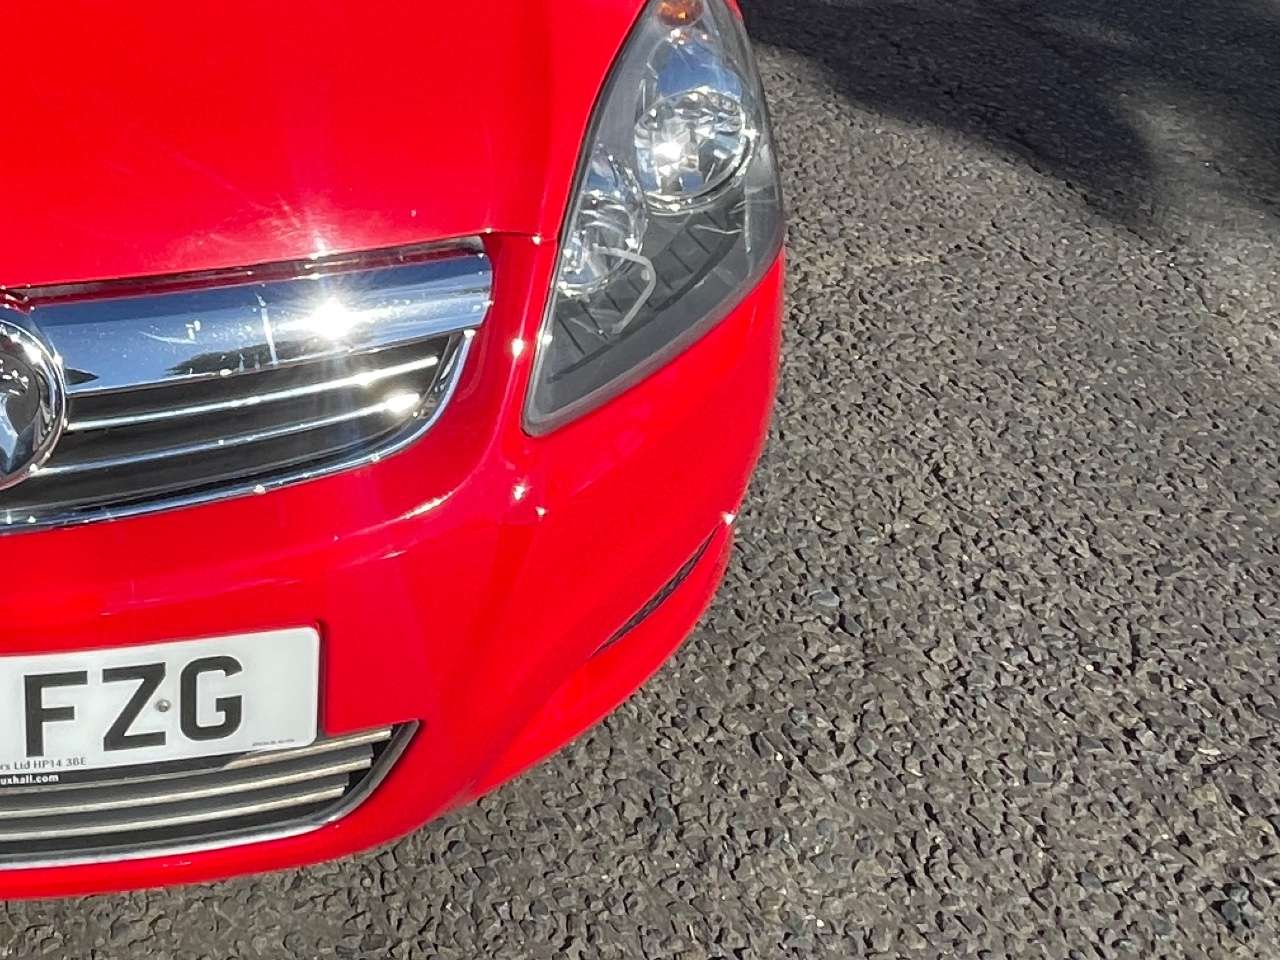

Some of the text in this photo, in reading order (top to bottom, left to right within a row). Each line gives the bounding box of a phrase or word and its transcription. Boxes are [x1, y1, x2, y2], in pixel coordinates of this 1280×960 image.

[24, 654, 243, 758] FZG
[14, 760, 30, 771] Ltd
[33, 758, 62, 769] HP14
